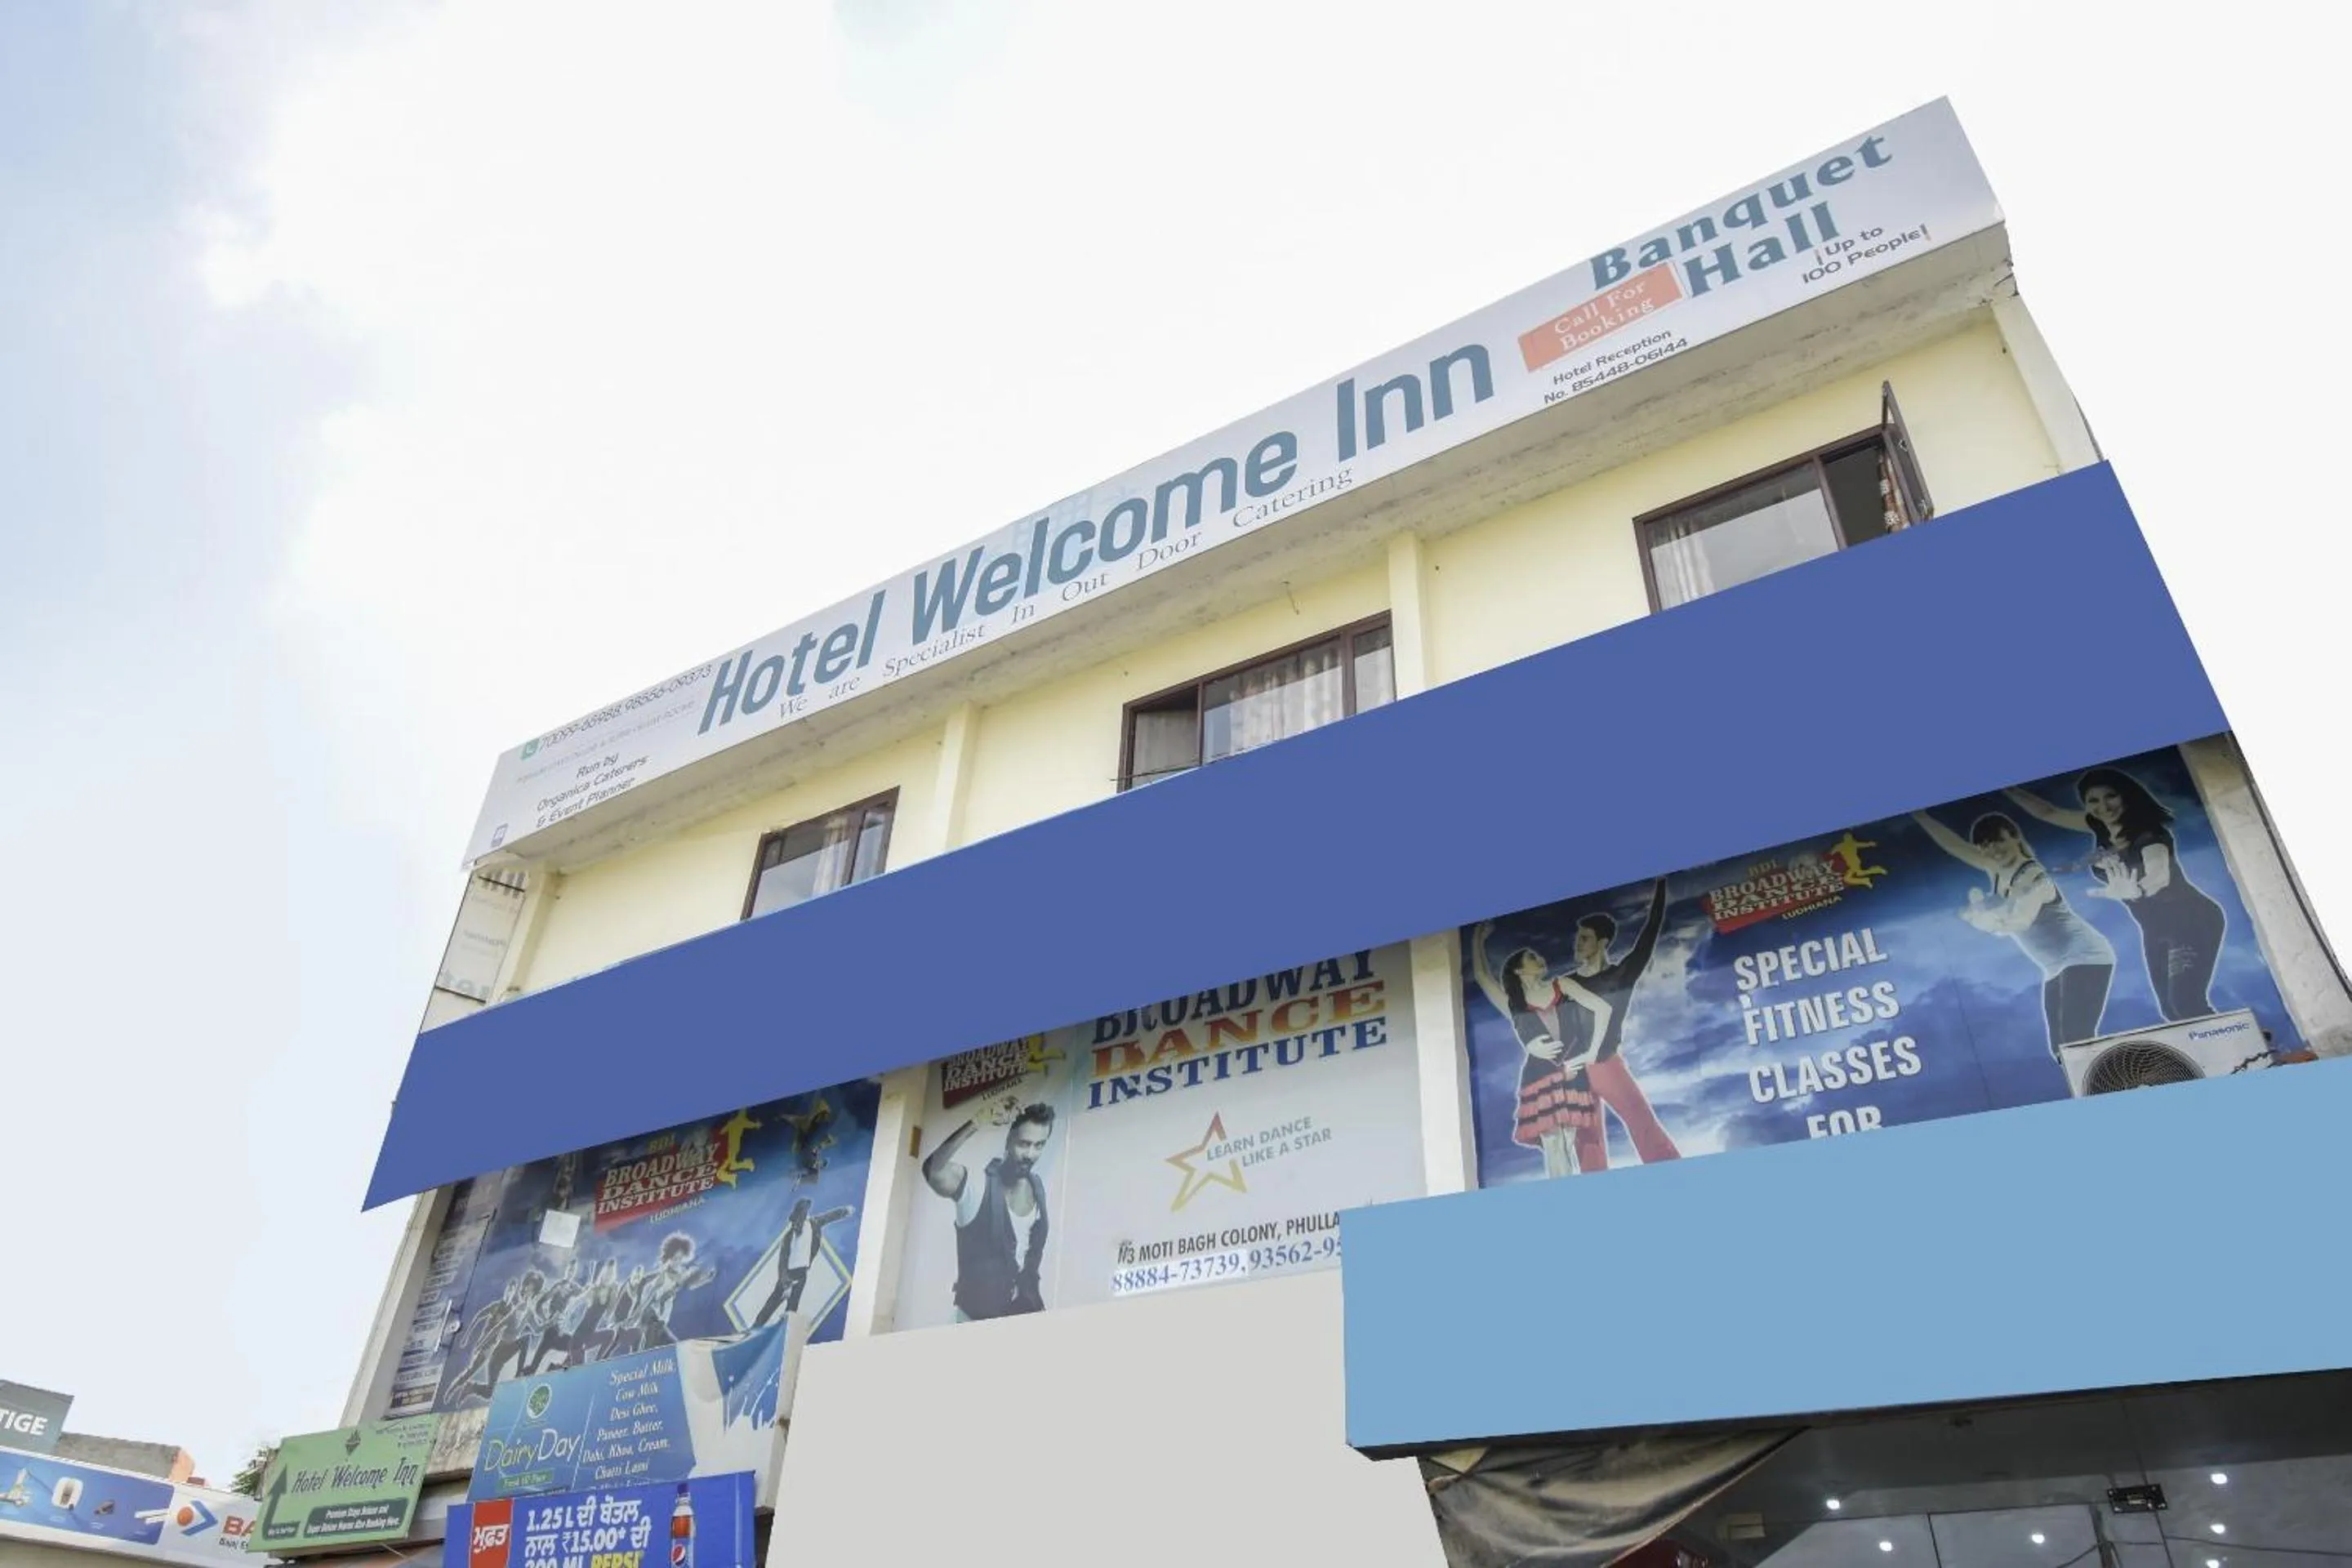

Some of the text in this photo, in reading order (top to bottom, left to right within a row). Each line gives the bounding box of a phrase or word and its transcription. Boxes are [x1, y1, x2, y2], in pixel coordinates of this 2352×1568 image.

[1589, 134, 1893, 291] Banquet
[1683, 200, 1841, 299] Hall
[1824, 227, 1883, 256] Up to
[1802, 261, 1842, 283] 100
[1555, 281, 1646, 333] Call For
[1560, 297, 1655, 350] Booking
[1544, 338, 1688, 403] No. 85448-06144
[1552, 330, 1672, 385] Hotel Reception
[697, 344, 1494, 736] Hotel Welcome Inn
[778, 466, 1355, 719] We are Specialist In Out Door Catering
[1709, 859, 1834, 904] BROADWAY
[1713, 873, 1843, 911] DANCE
[1715, 883, 1845, 920] INSTITUTE
[1733, 927, 1888, 991] SPECIAL
[1092, 980, 1385, 1077] DANCE
[1744, 980, 1900, 1046] FITNESS
[2189, 1022, 2250, 1040] Panasonic
[943, 1063, 1027, 1092] INSTITUTE
[1087, 1016, 1388, 1110] INSTITUTE
[1748, 1035, 1922, 1104] CLASSES
[1206, 1116, 1312, 1161] LEARN DANCE
[1806, 1105, 1883, 1140] FOR
[604, 1142, 720, 1187] BROADWAY
[1241, 1128, 1332, 1167] LIKE A STAR
[598, 1176, 715, 1214] INSTITUTE
[601, 1163, 718, 1200] DANCE
[1138, 1241, 1174, 1263] MOTI
[1178, 1234, 1217, 1254] BAGH
[1220, 1221, 1281, 1247] COLONY,
[609, 1362, 648, 1388] Special
[615, 1388, 635, 1401] Cow
[291, 1457, 419, 1494] Hotel Welcome Inn
